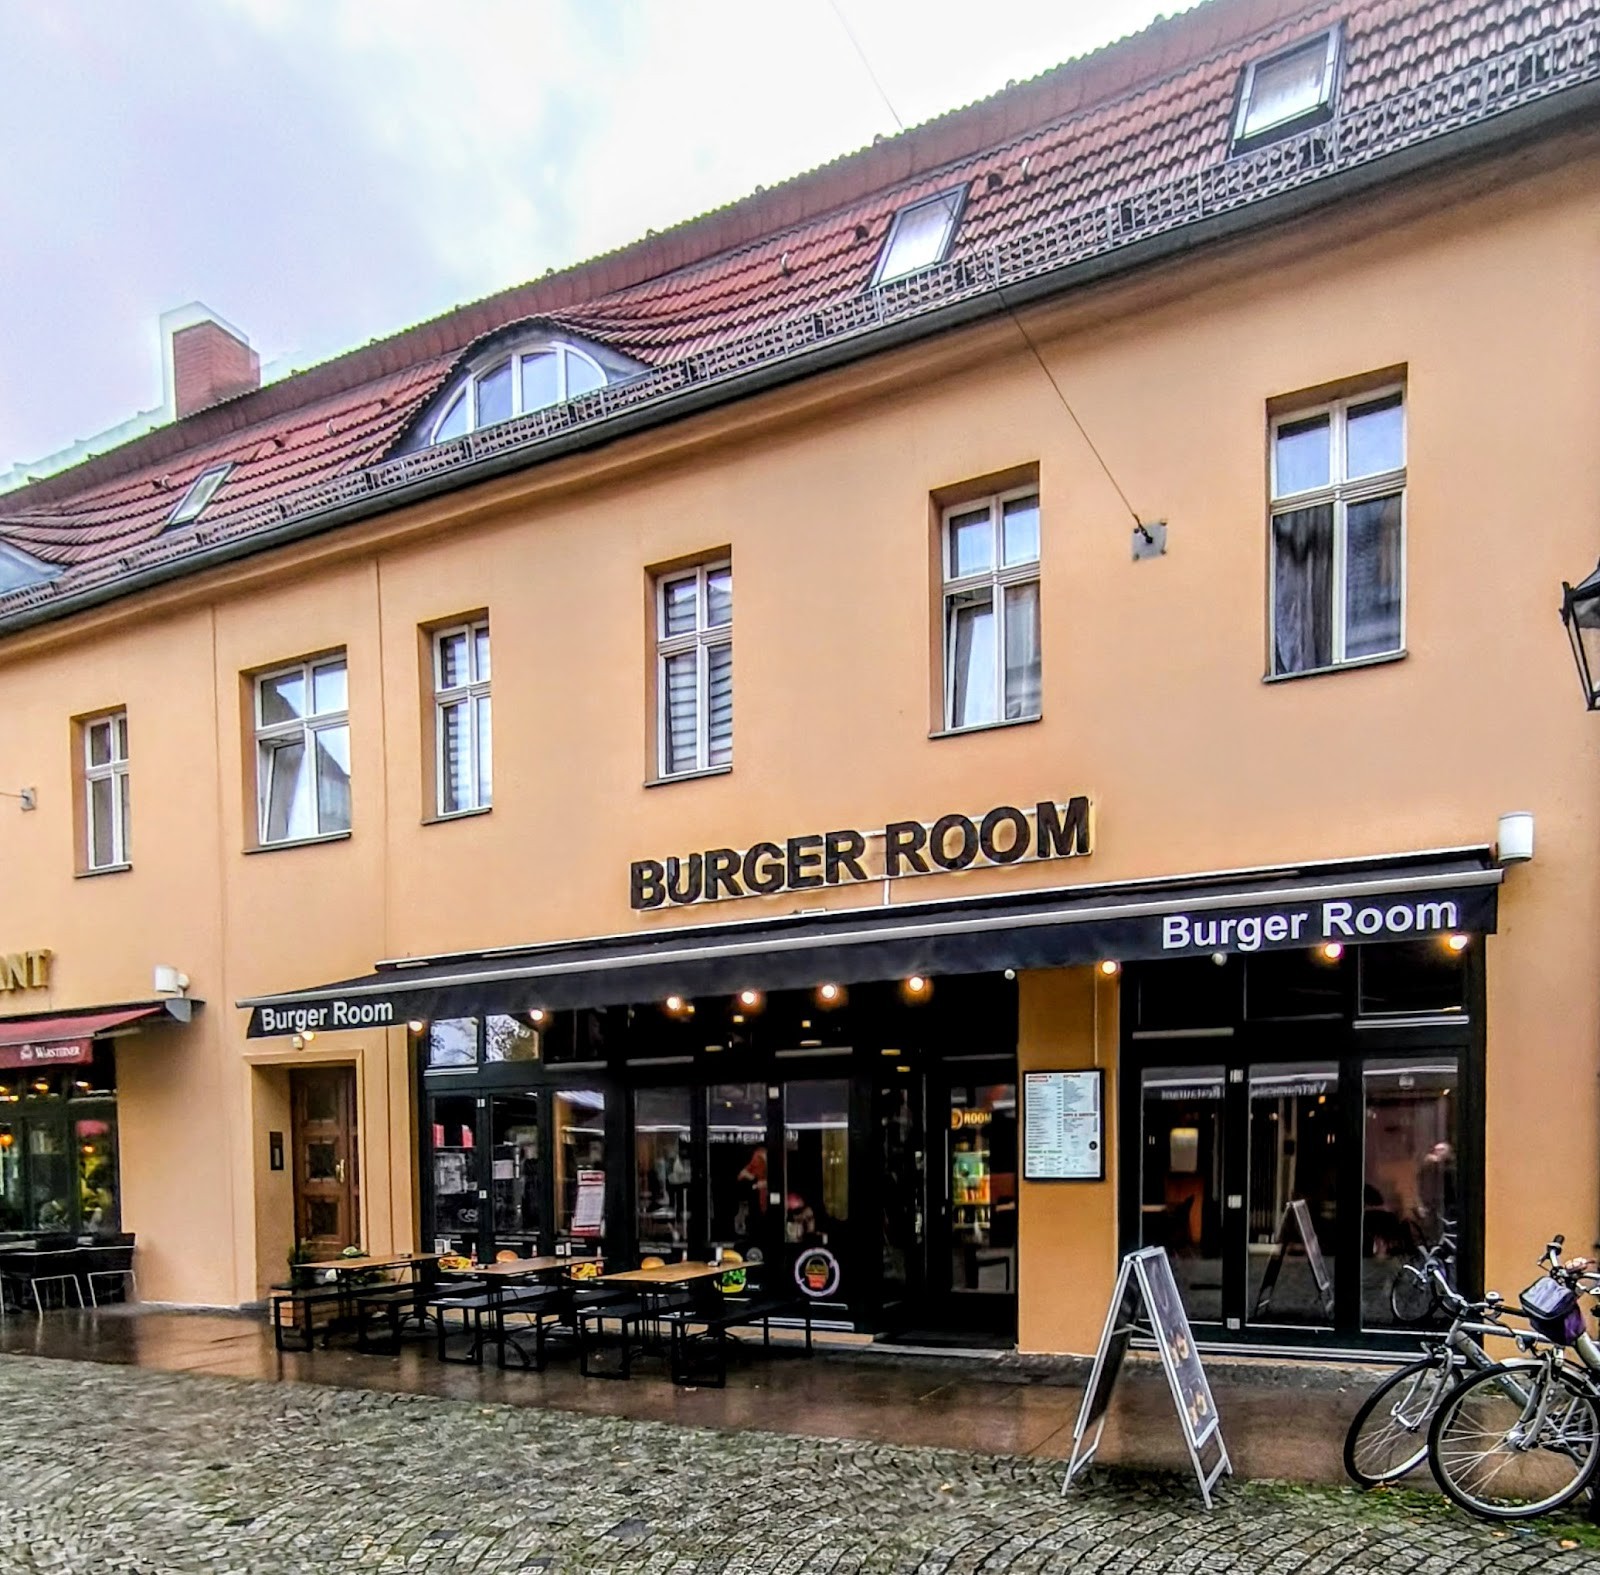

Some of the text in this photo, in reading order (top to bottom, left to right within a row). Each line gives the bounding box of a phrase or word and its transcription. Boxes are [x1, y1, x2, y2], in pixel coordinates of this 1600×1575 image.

[630, 796, 1090, 910] BURGER ROOM
[1163, 901, 1458, 952] Burger Room
[261, 1001, 393, 1033] Burger Room
